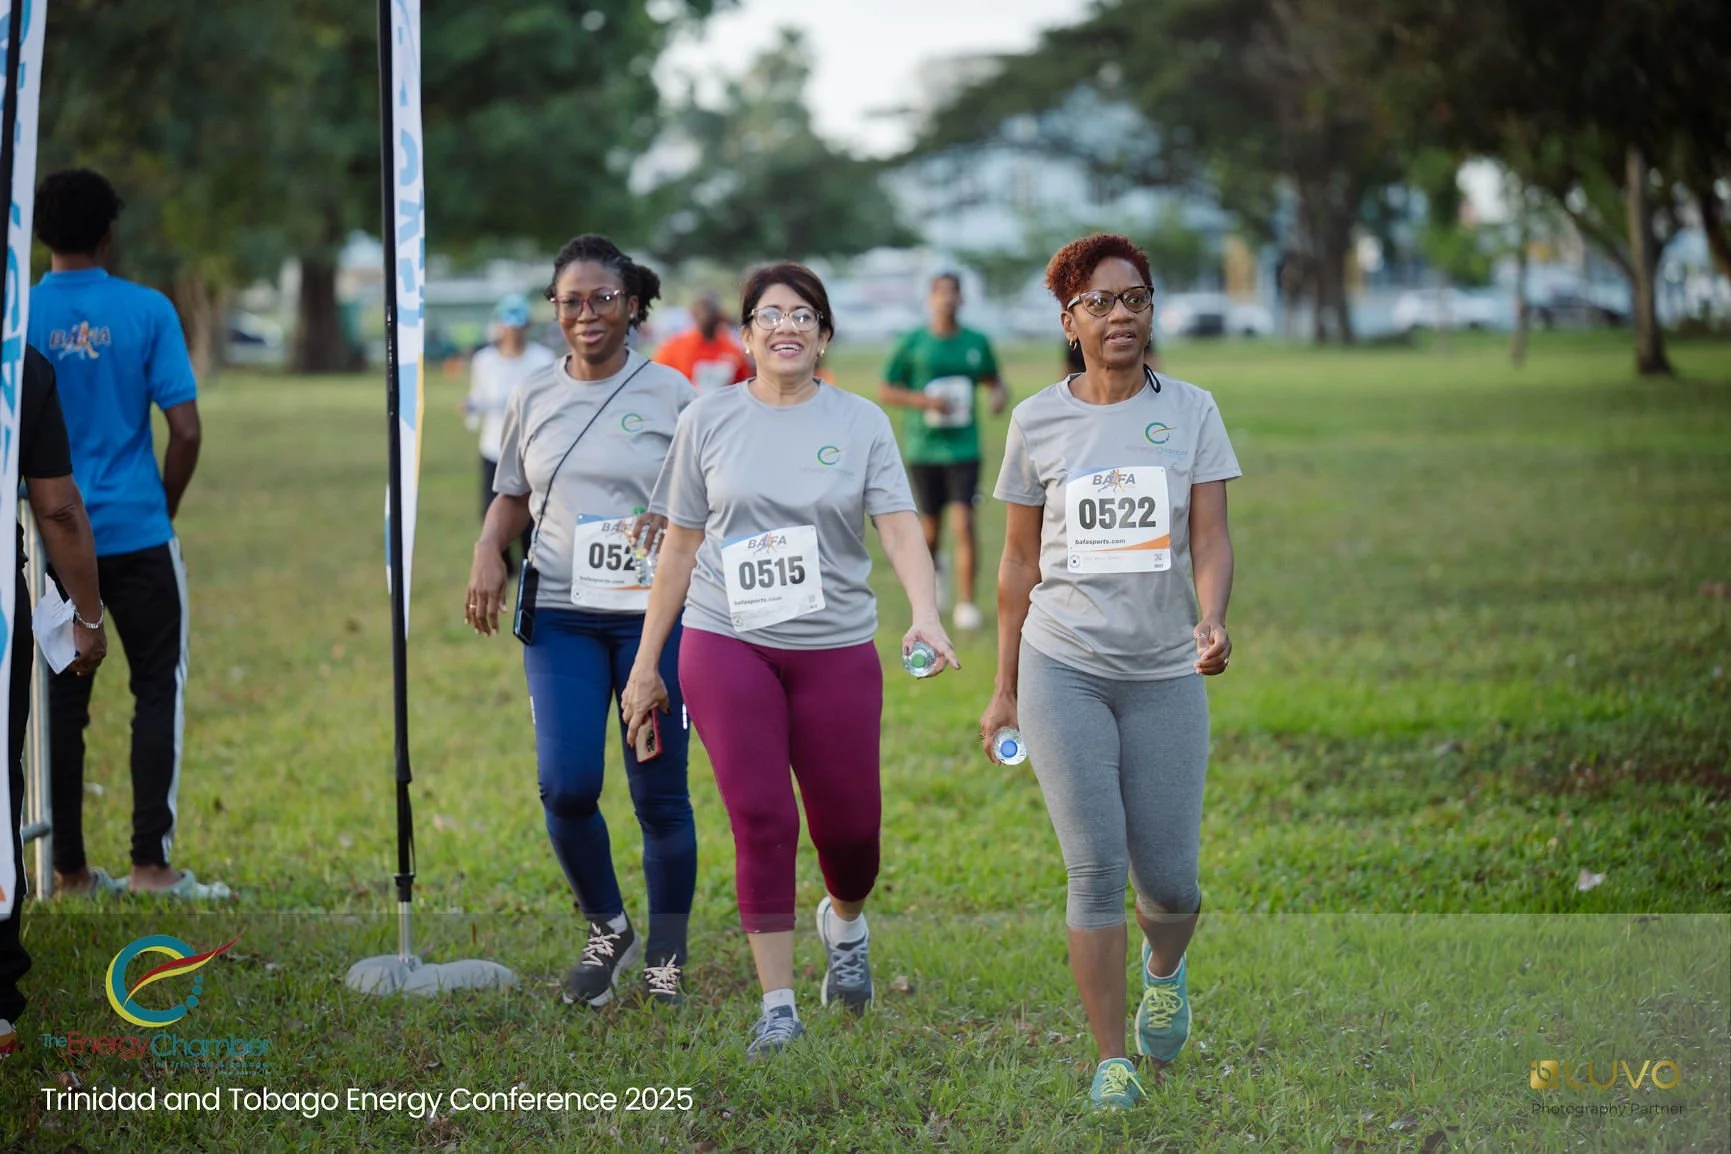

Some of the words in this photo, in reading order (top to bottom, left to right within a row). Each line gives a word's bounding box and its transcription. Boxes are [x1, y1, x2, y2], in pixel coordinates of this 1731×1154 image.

[1092, 472, 1136, 486] BAFA
[1078, 496, 1156, 530] 0522
[747, 535, 787, 549] BAFA
[1074, 538, 1126, 546] bafasports.com
[588, 542, 636, 571] 052
[738, 555, 806, 591] 0515
